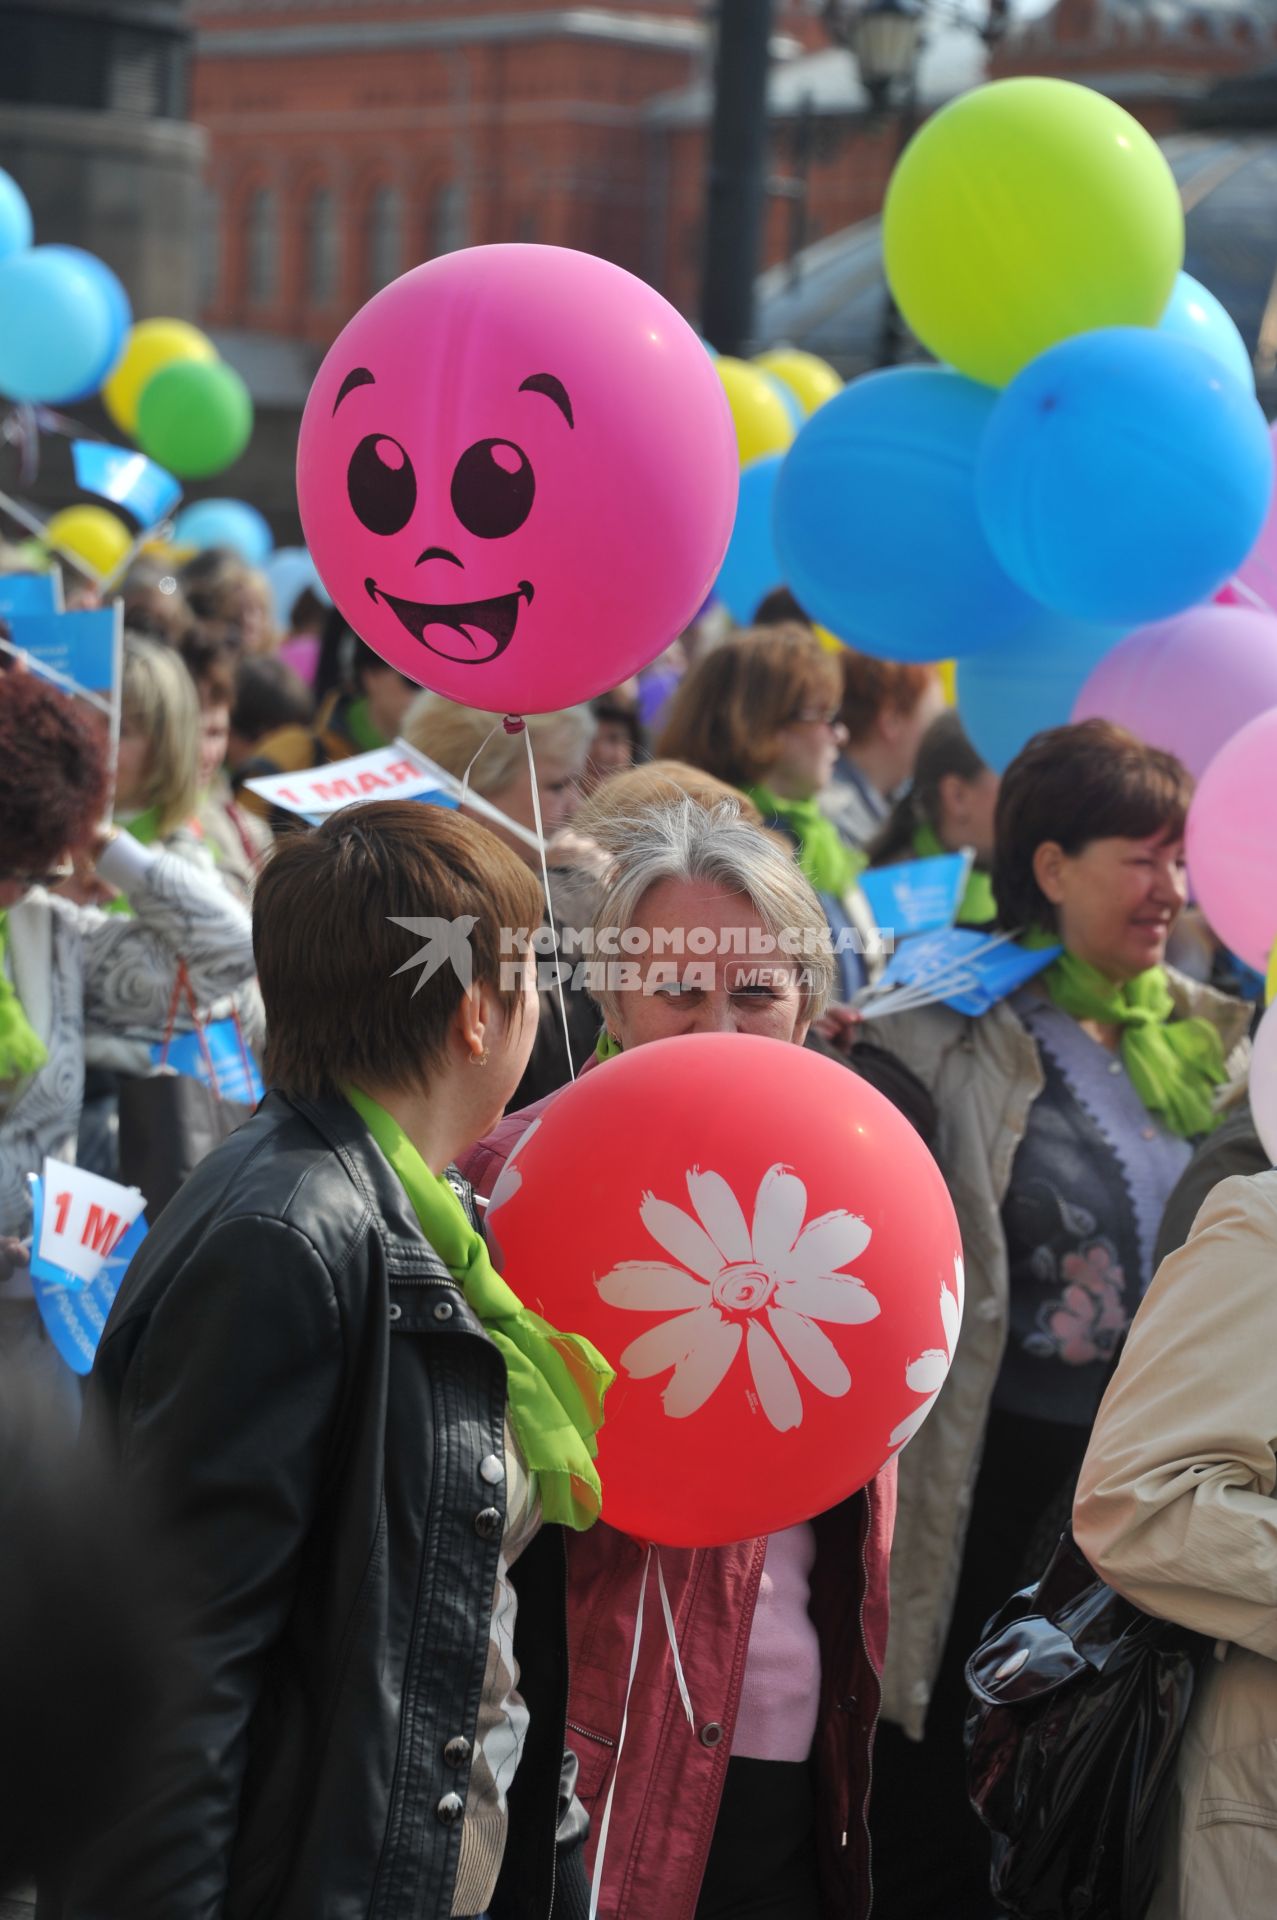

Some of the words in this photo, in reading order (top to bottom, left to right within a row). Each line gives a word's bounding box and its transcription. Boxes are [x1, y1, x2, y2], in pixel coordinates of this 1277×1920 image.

[276, 786, 302, 805] 1
[309, 758, 424, 802] МАЯ
[53, 1190, 73, 1235] 1
